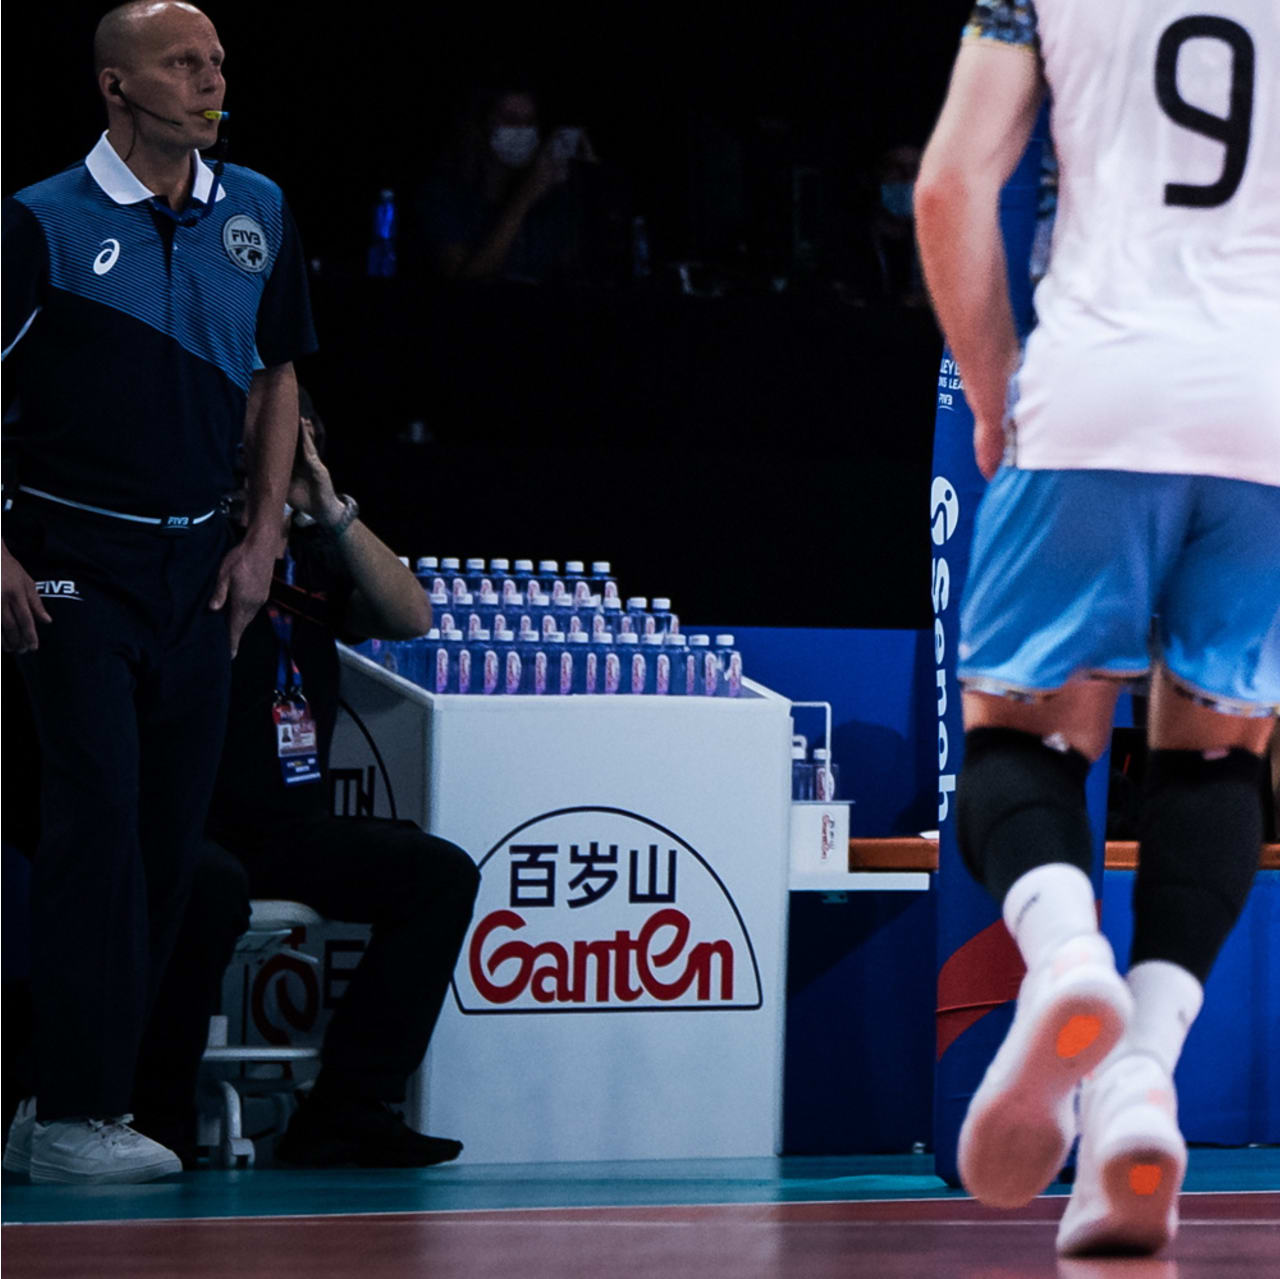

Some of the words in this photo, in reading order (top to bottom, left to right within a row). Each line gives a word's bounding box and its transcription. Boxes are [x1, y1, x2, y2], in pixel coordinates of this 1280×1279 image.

[1154, 14, 1256, 210] 9
[232, 228, 262, 246] FIVB
[36, 580, 75, 595] FIVB
[509, 841, 677, 909] 百岁山
[469, 908, 735, 1005] Ganten
